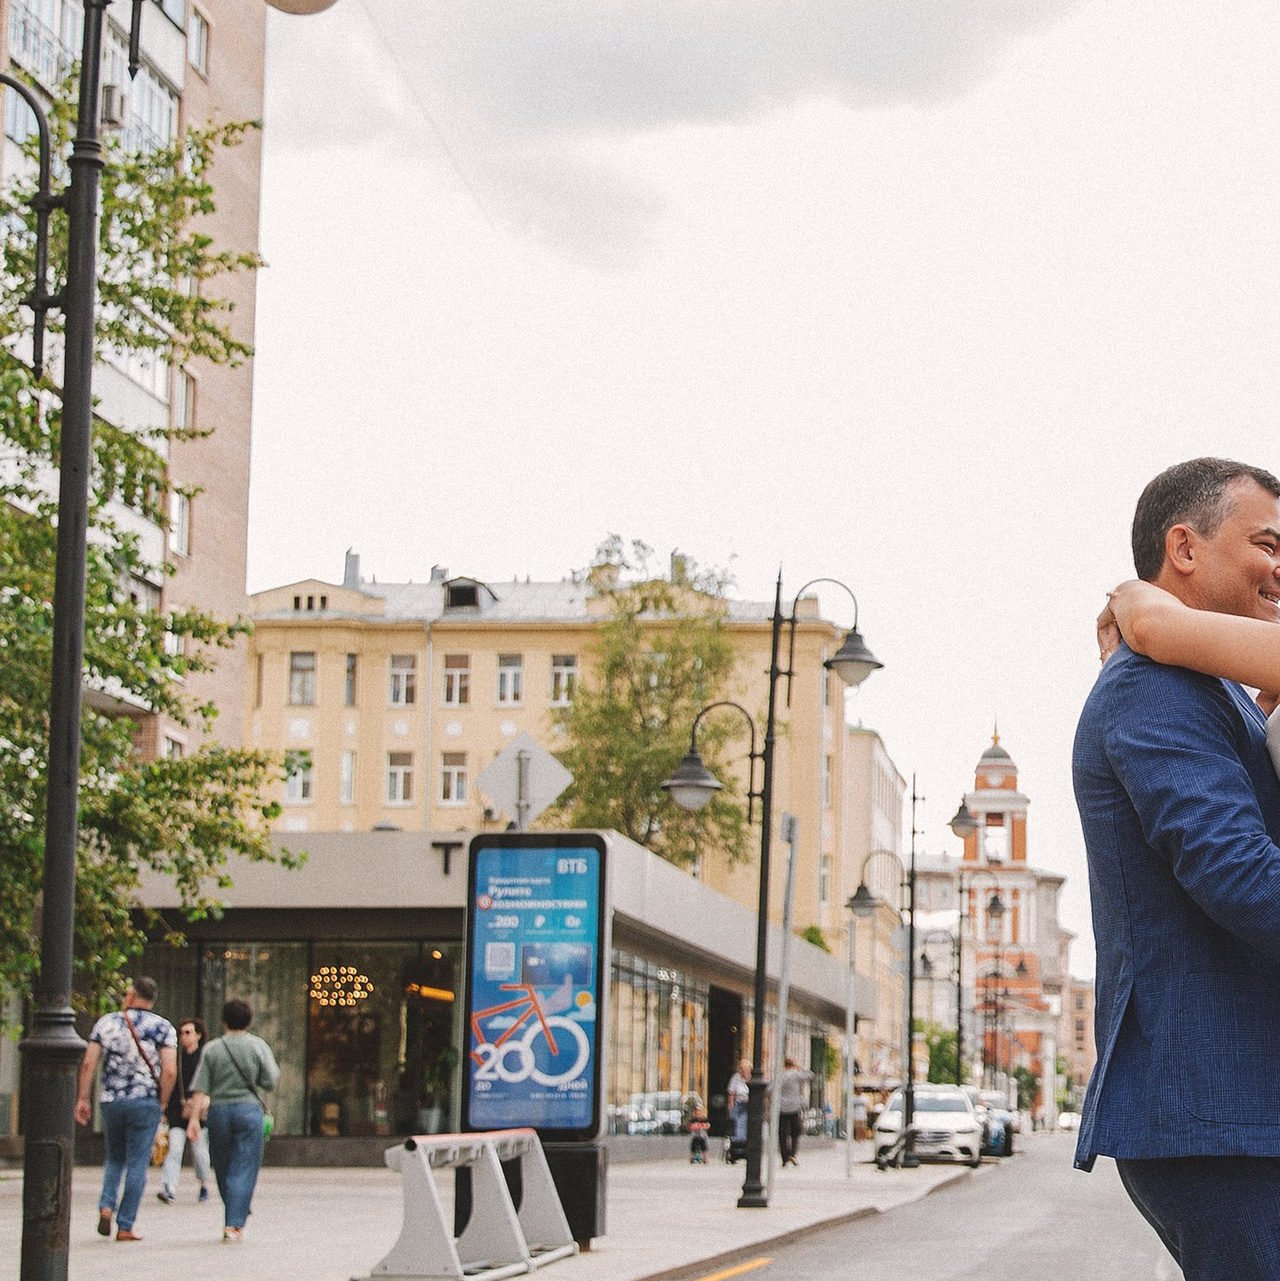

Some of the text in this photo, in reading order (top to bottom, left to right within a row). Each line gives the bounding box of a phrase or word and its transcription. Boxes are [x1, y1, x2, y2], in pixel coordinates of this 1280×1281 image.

[557, 858, 588, 874] ВТБ
[488, 885, 532, 899] Рулите
[557, 1079, 588, 1091] дней
